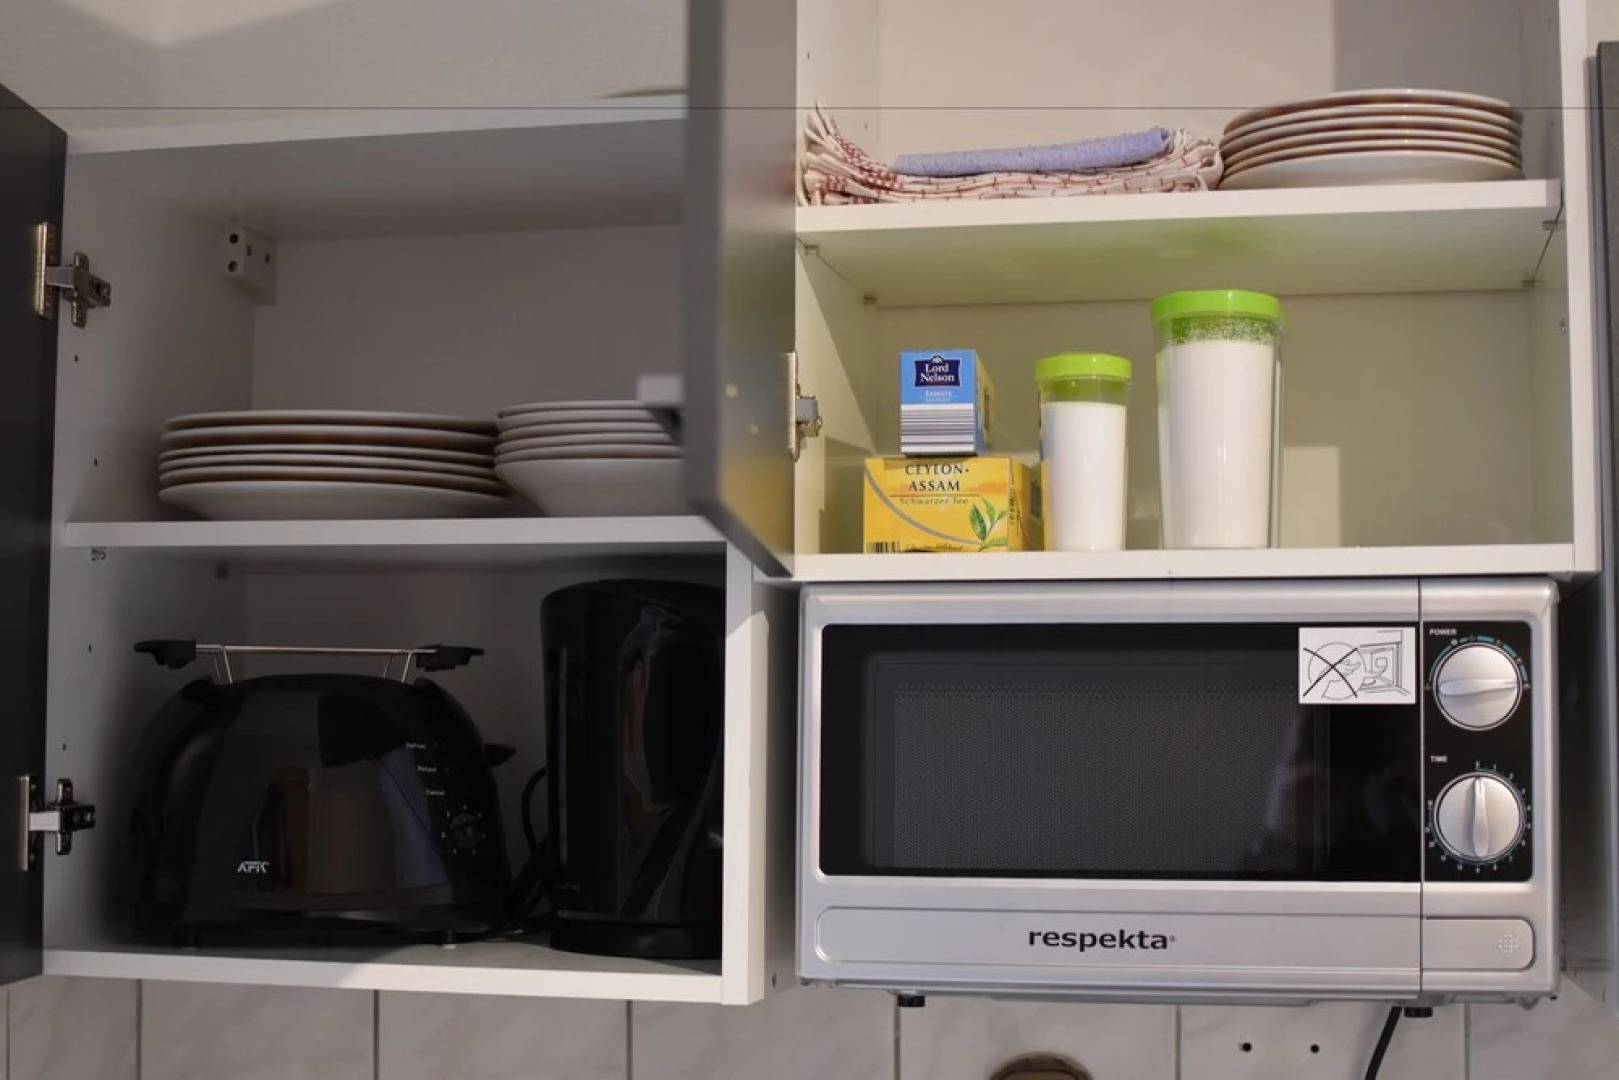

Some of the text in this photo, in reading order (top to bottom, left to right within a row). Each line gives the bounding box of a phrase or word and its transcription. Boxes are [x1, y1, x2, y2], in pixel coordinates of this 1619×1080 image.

[925, 362, 949, 373] Lord
[920, 373, 955, 383] Nelson
[907, 480, 960, 492] ASSAM
[1429, 628, 1457, 636] POWER
